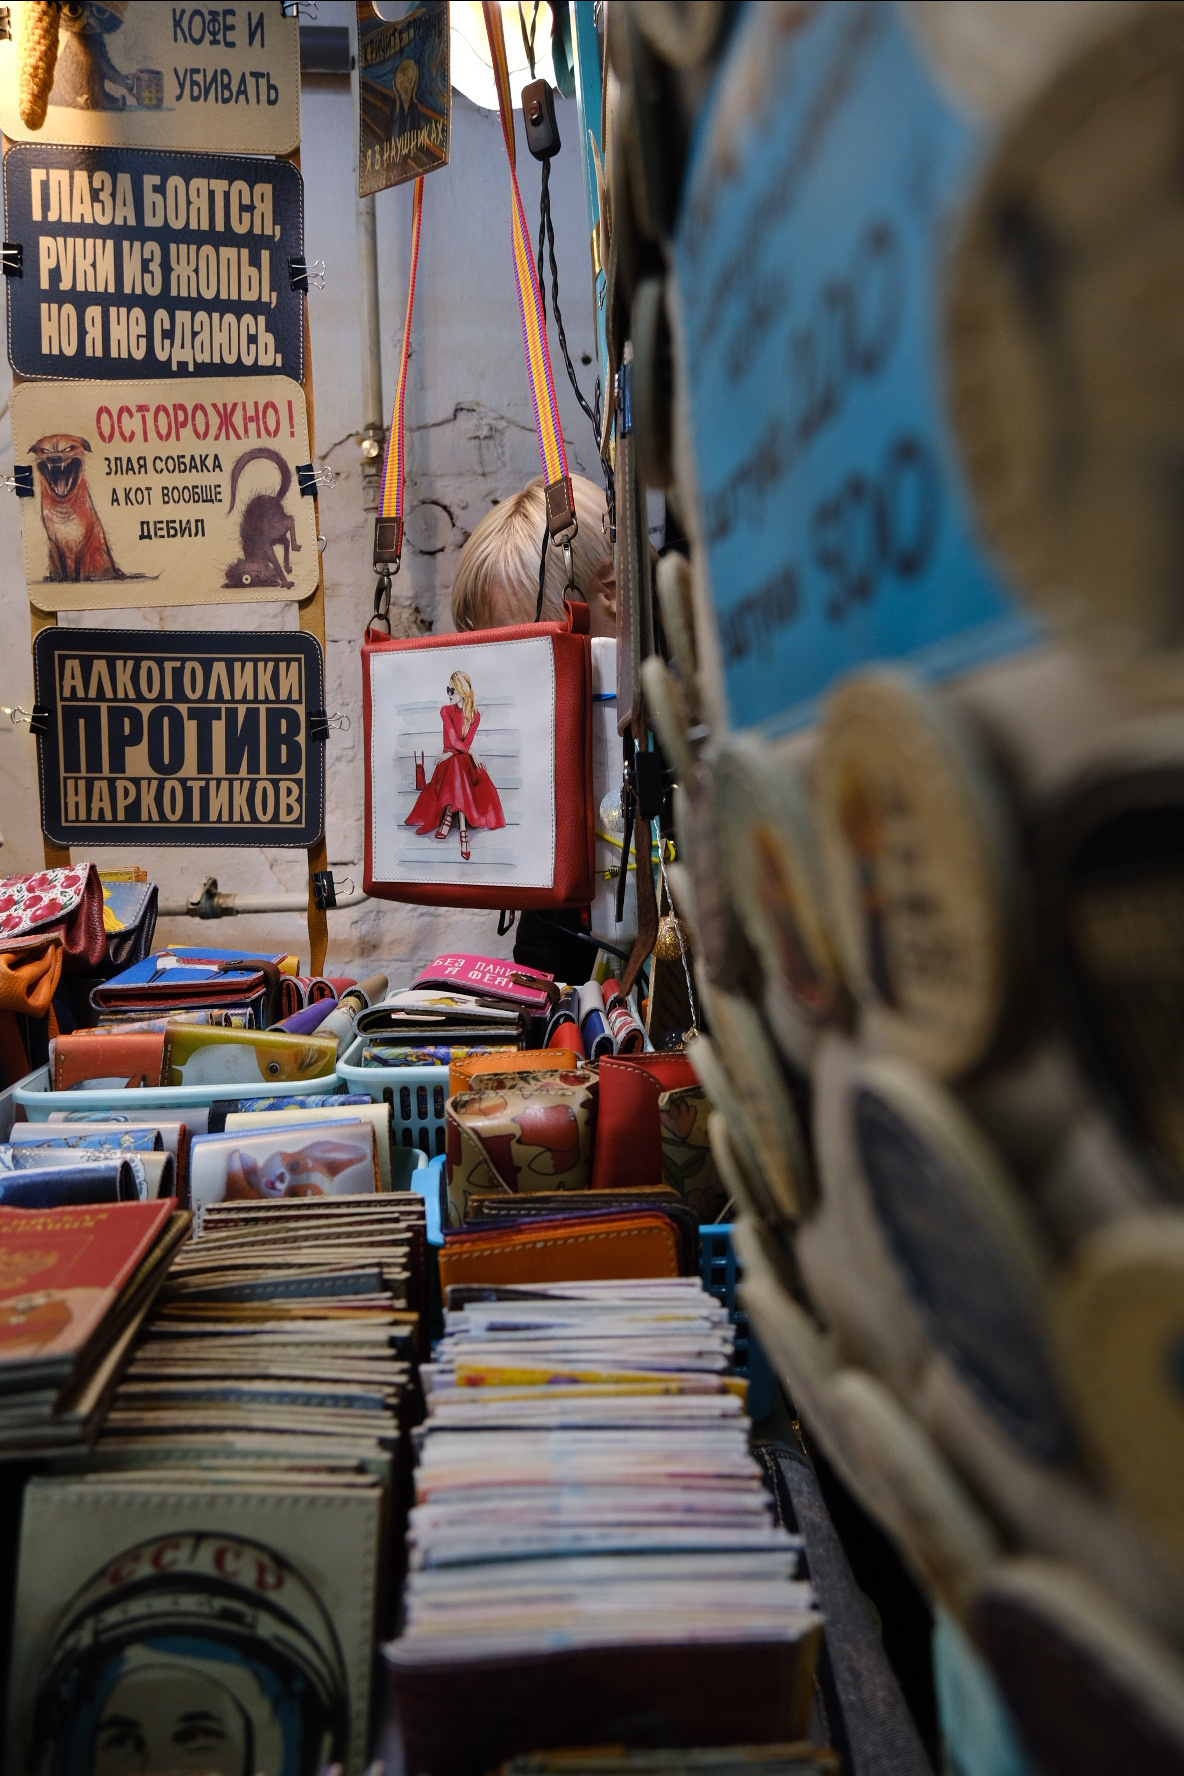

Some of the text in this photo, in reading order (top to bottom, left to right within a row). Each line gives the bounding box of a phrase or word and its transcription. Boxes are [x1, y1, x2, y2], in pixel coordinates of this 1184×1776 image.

[172, 8, 265, 48] КОФЕ И
[173, 66, 279, 106] УБИВАТЬ
[366, 119, 444, 172] Я В НАУШНИКАХ
[30, 168, 281, 242] ГЛАЗА БОЯТСЯ,
[38, 235, 278, 309] РУКИ ИЗ ЖОПЫ,
[105, 454, 223, 476] ЗЛАЯ СОБАКА
[111, 484, 223, 507] А КОТ ВООБЩЕ
[139, 518, 206, 541] ДЕБИЛ
[62, 659, 300, 701] АЛКОГОЛИКИ
[63, 704, 303, 776] ПРОТИВ
[65, 778, 301, 823] НАРКОТИКОВ
[432, 958, 466, 968] БЕЗ
[445, 967, 462, 975] Я
